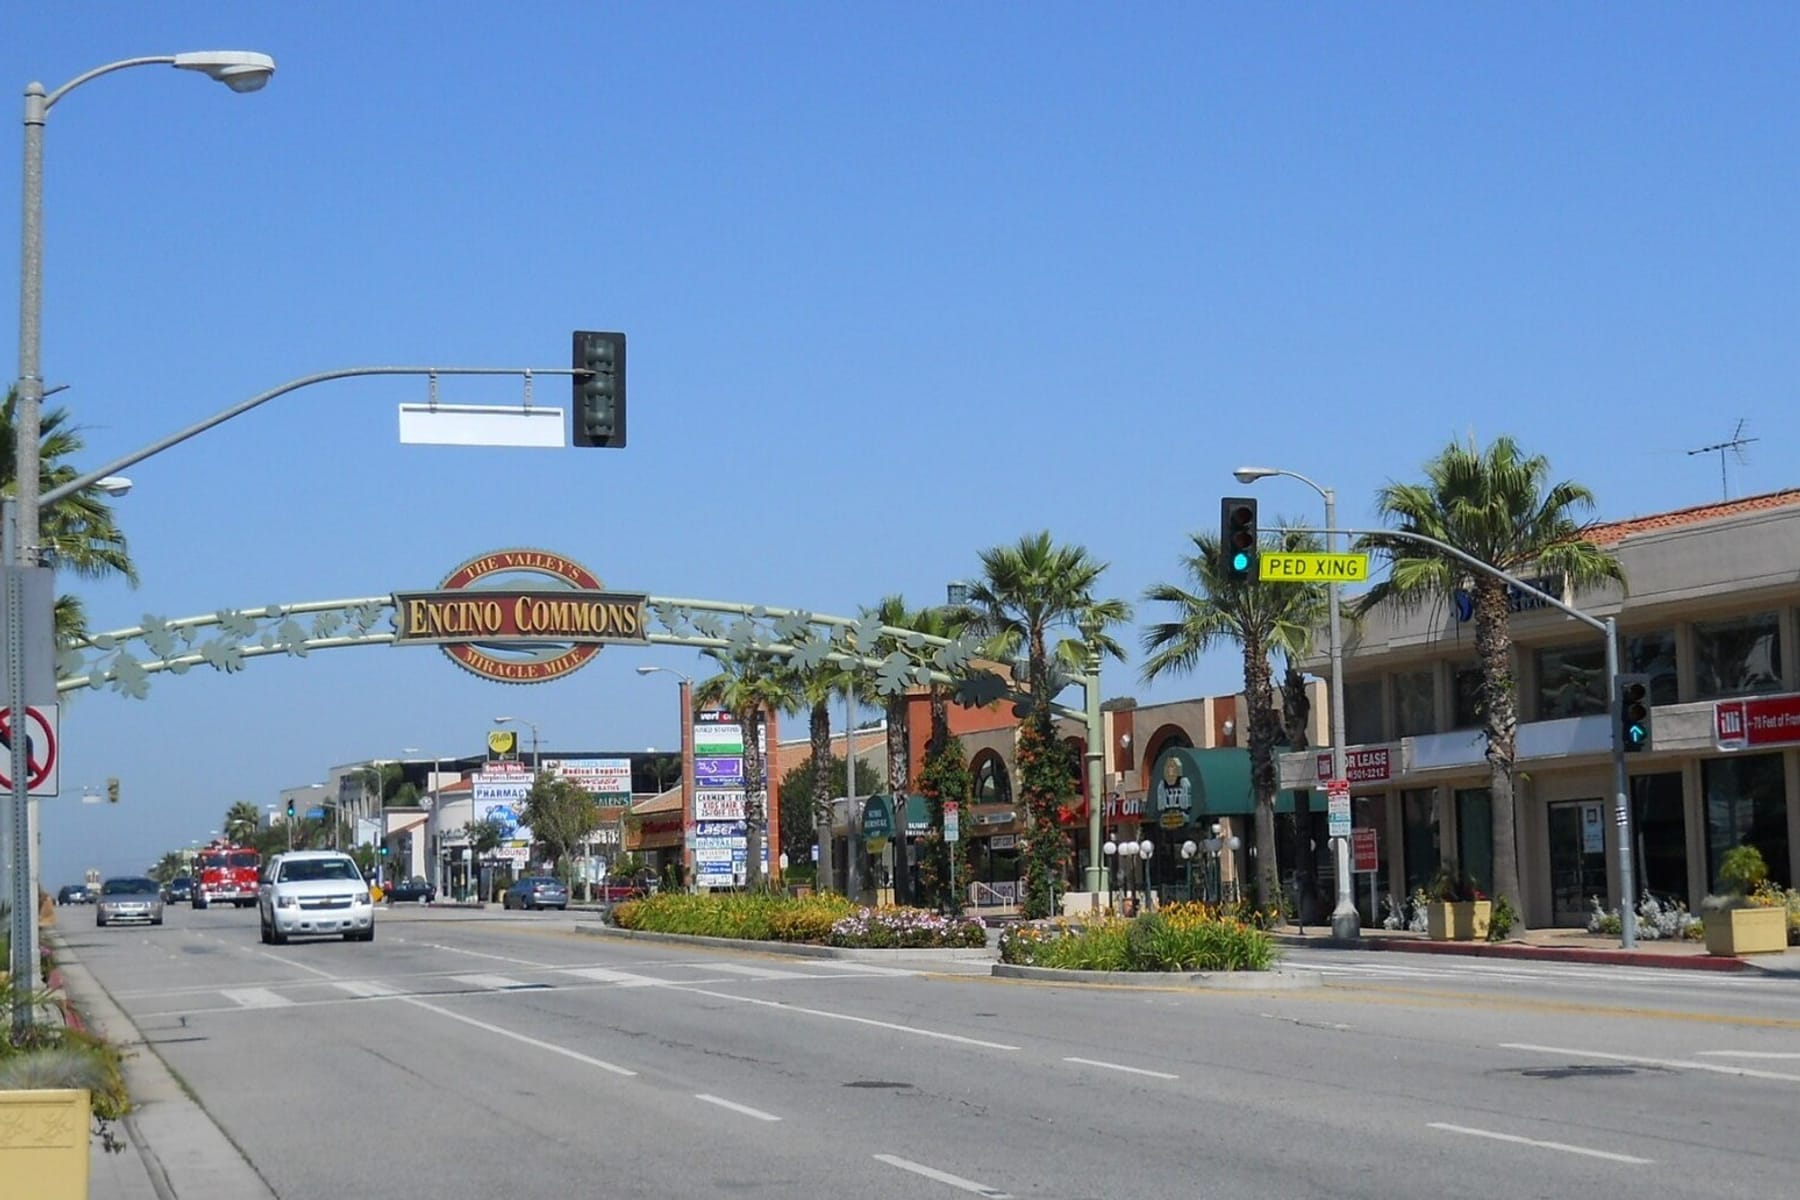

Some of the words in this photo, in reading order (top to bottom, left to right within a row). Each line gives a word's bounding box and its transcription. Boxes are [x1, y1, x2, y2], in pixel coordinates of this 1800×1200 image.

[463, 556, 499, 578] THE
[505, 552, 580, 579] VALLEY'S
[1269, 559, 1306, 575] PED
[1316, 559, 1358, 576] XING
[409, 598, 502, 634] ENCINO
[514, 595, 637, 635] COMMONS
[463, 649, 538, 678] MIRACLE
[543, 650, 584, 676] MILE
[1357, 751, 1387, 768] LEASE
[476, 789, 525, 799] PHARMAC
[696, 822, 736, 835] Laser
